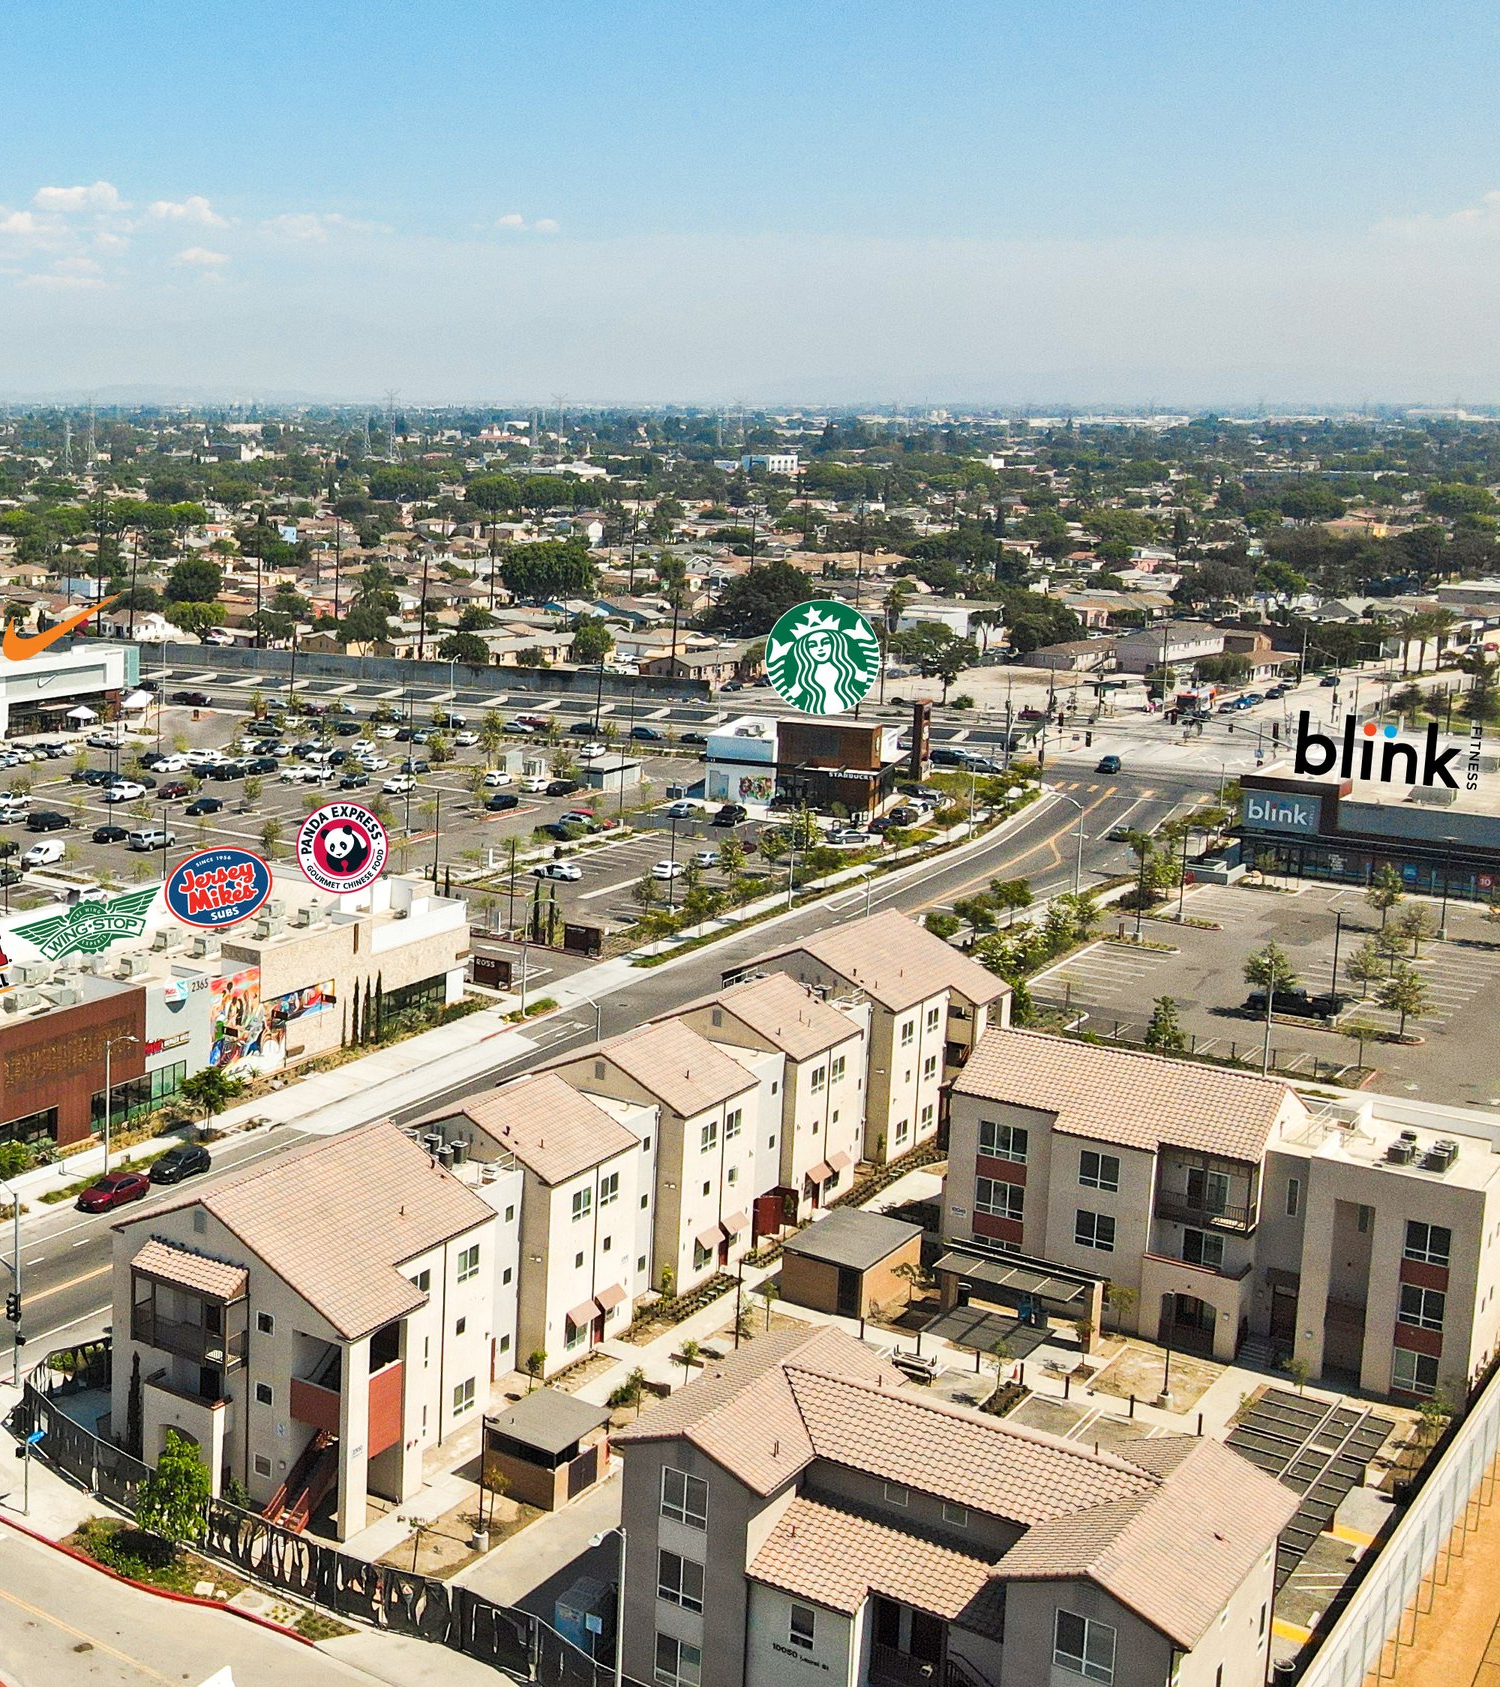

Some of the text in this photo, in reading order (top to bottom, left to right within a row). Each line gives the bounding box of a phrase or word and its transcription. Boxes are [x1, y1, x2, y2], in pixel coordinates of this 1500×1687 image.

[828, 771, 874, 781] STARBUCKS
[1248, 799, 1307, 826] blink
[476, 958, 496, 968] ROSS
[191, 978, 208, 992] 2365
[772, 1643, 798, 1658] 10050
